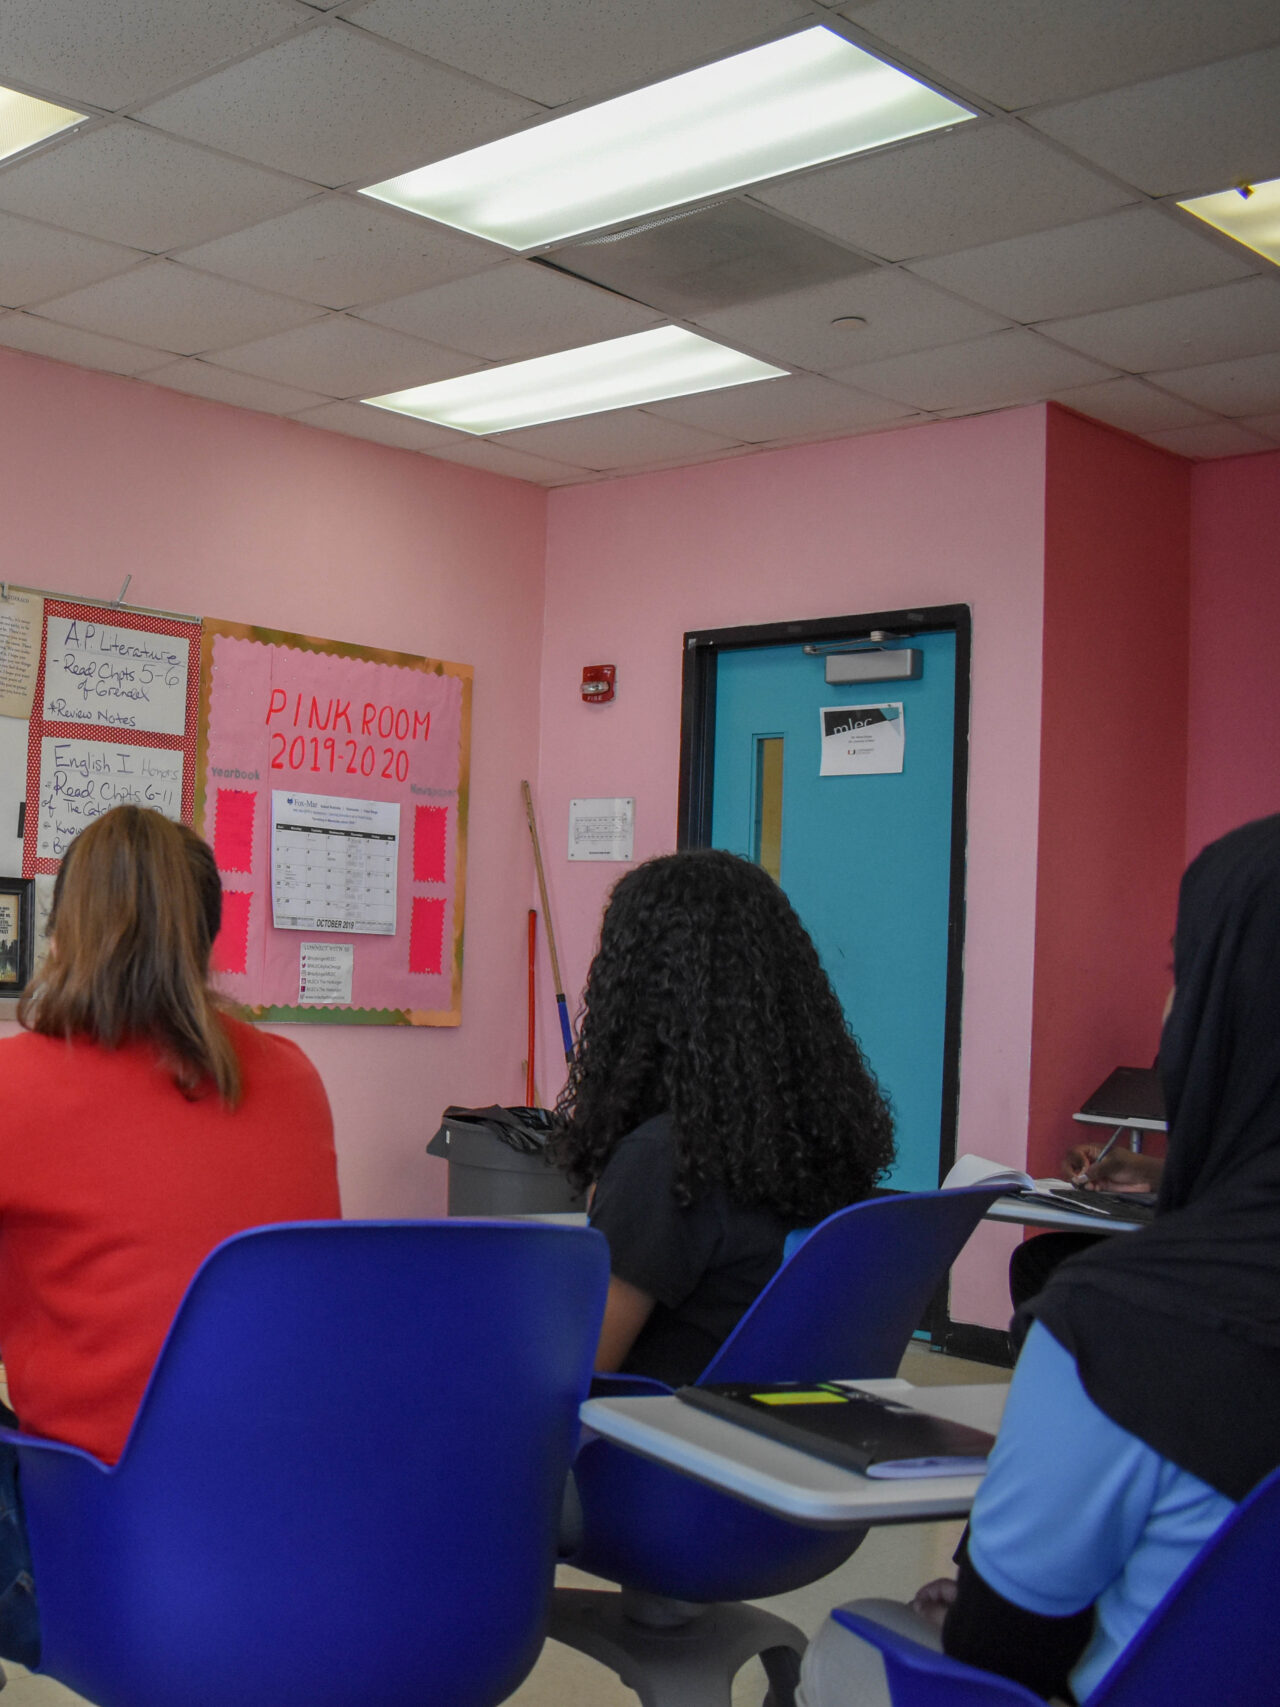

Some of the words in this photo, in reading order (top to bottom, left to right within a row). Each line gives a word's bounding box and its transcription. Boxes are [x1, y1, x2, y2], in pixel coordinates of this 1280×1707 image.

[100, 630, 181, 666] Literature
[64, 653, 97, 678] Read
[98, 663, 136, 688] Chpts
[139, 664, 180, 688] 5-6
[78, 678, 95, 701] of
[95, 680, 150, 702] Grendel
[97, 708, 136, 727] Notes
[265, 688, 352, 734] PINK
[361, 702, 431, 741] ROOM
[833, 718, 873, 735] mlec
[54, 744, 111, 777] English
[116, 753, 134, 774] I
[211, 767, 260, 780] Yearbook
[54, 771, 95, 800] Read
[144, 784, 173, 805] 6-11
[63, 799, 82, 815] The
[316, 919, 342, 929] OCTOBER
[342, 921, 355, 930] 2019
